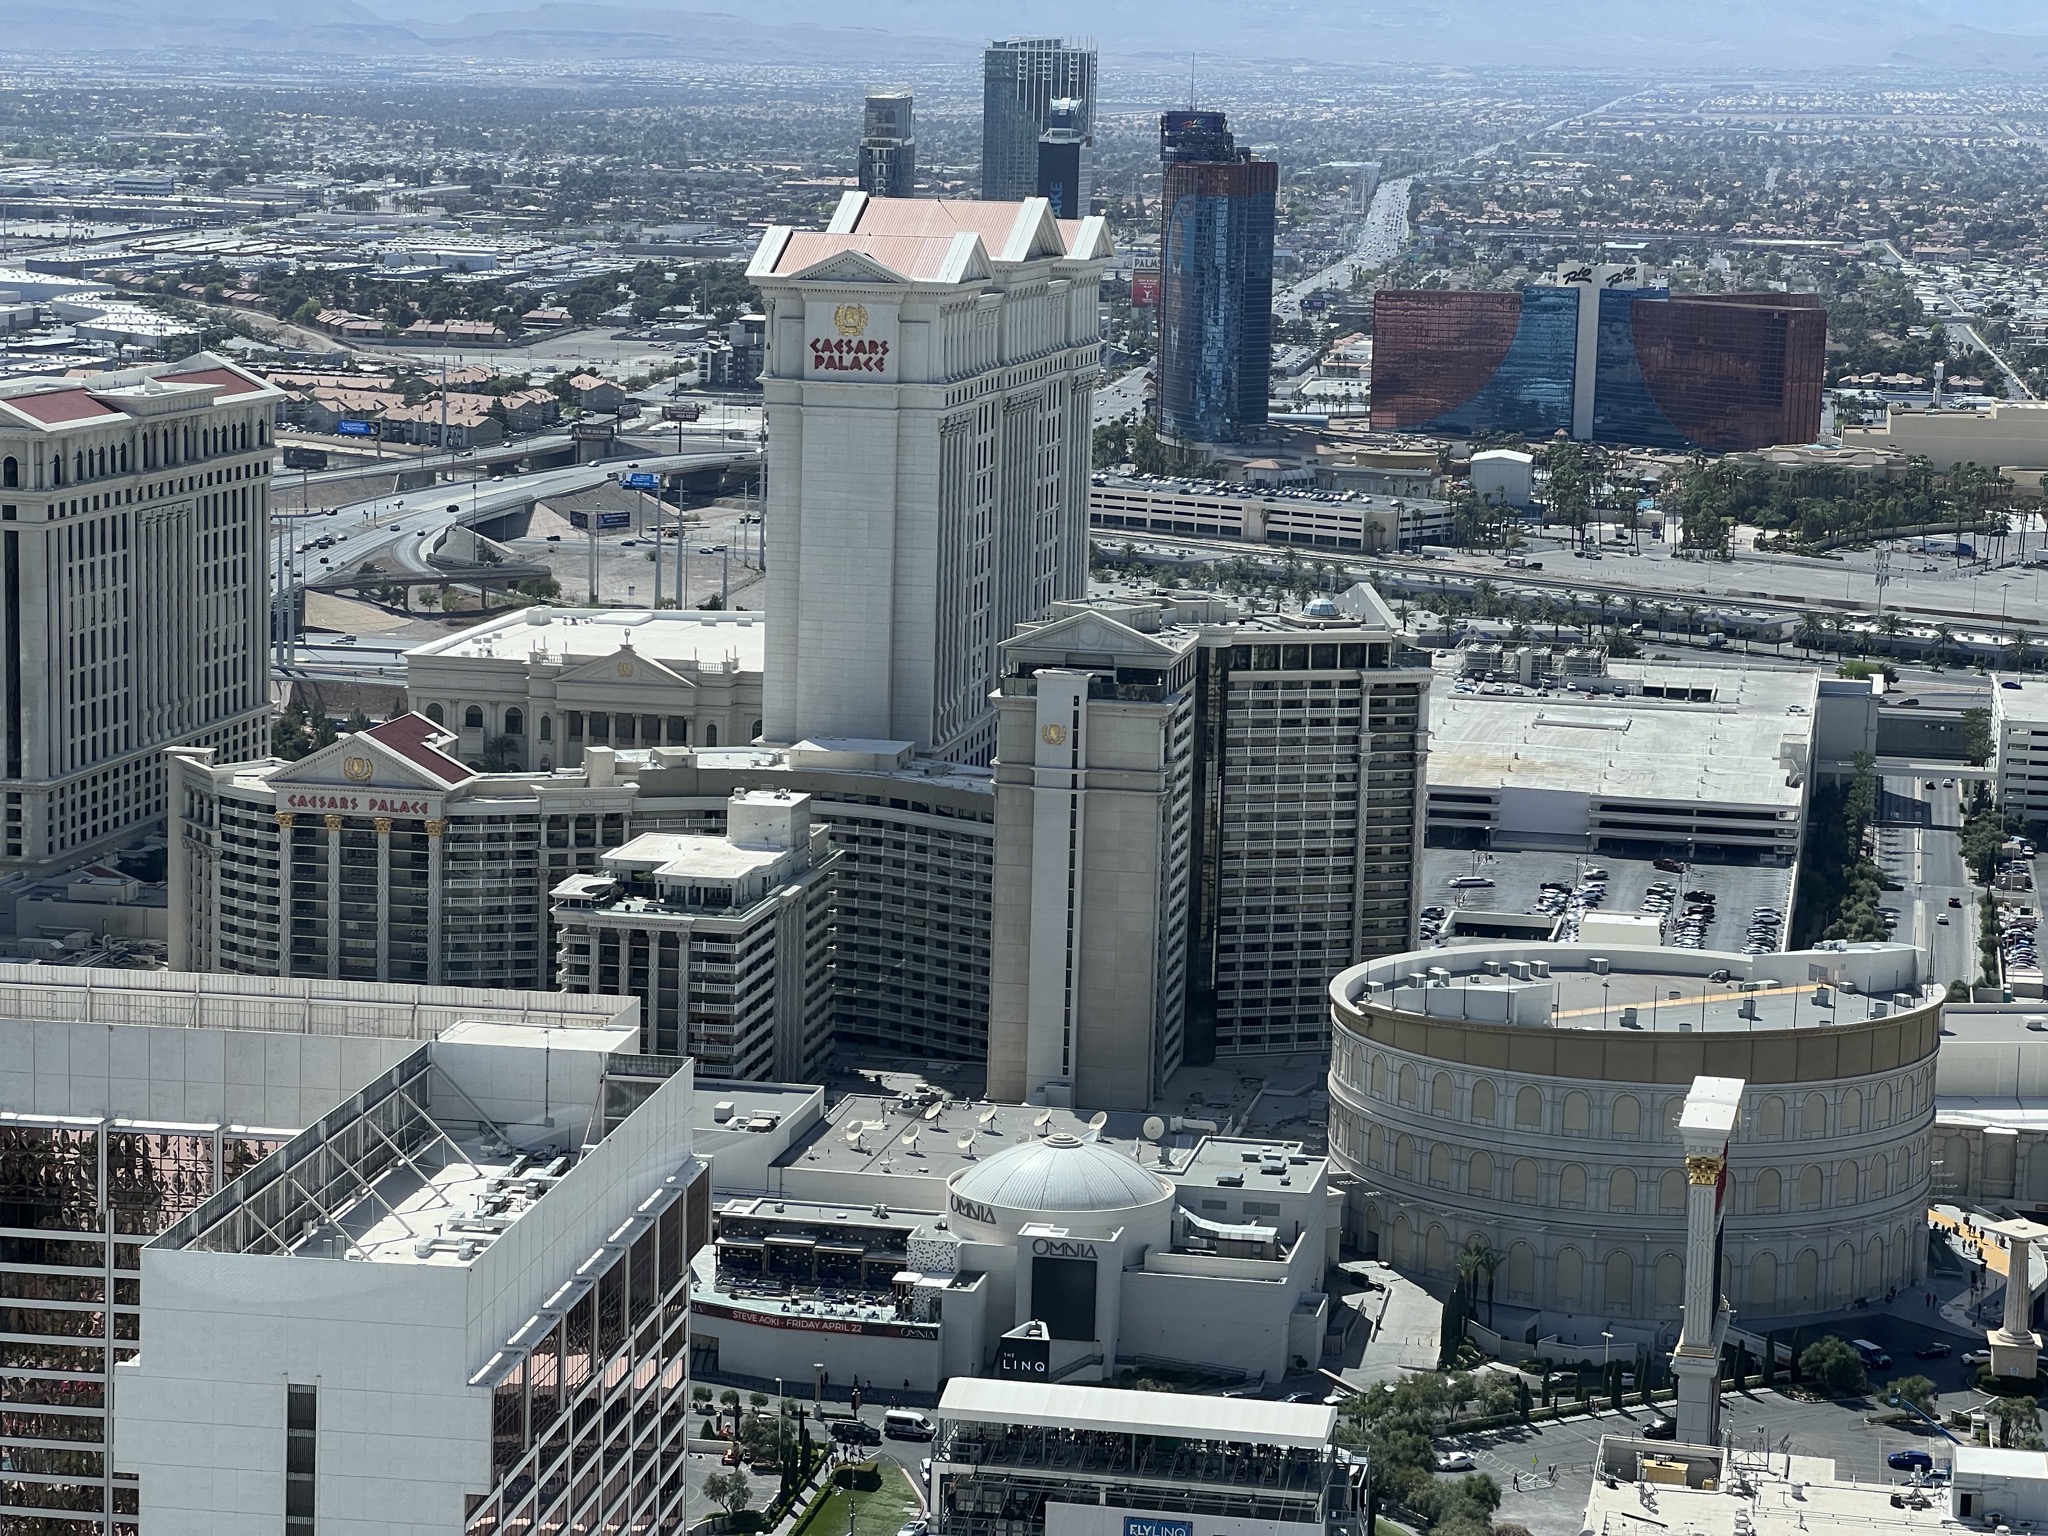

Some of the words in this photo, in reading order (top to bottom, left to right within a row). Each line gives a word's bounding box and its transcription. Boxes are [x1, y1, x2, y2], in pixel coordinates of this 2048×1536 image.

[809, 337, 889, 356] CAESARS
[814, 354, 885, 373] PALACE
[287, 794, 359, 811] CAESARS
[368, 798, 429, 815] PALACE
[950, 1193, 997, 1225] OMNIA
[1032, 1238, 1098, 1259] OMNIA
[732, 1310, 757, 1322] STEVE
[758, 1315, 780, 1326] AOKI
[786, 1319, 820, 1330] FRIDAY
[821, 1321, 850, 1332] APRIL
[851, 1324, 862, 1333] 22
[900, 1327, 935, 1339] OMNIA
[1003, 1359, 1045, 1372] LINQ
